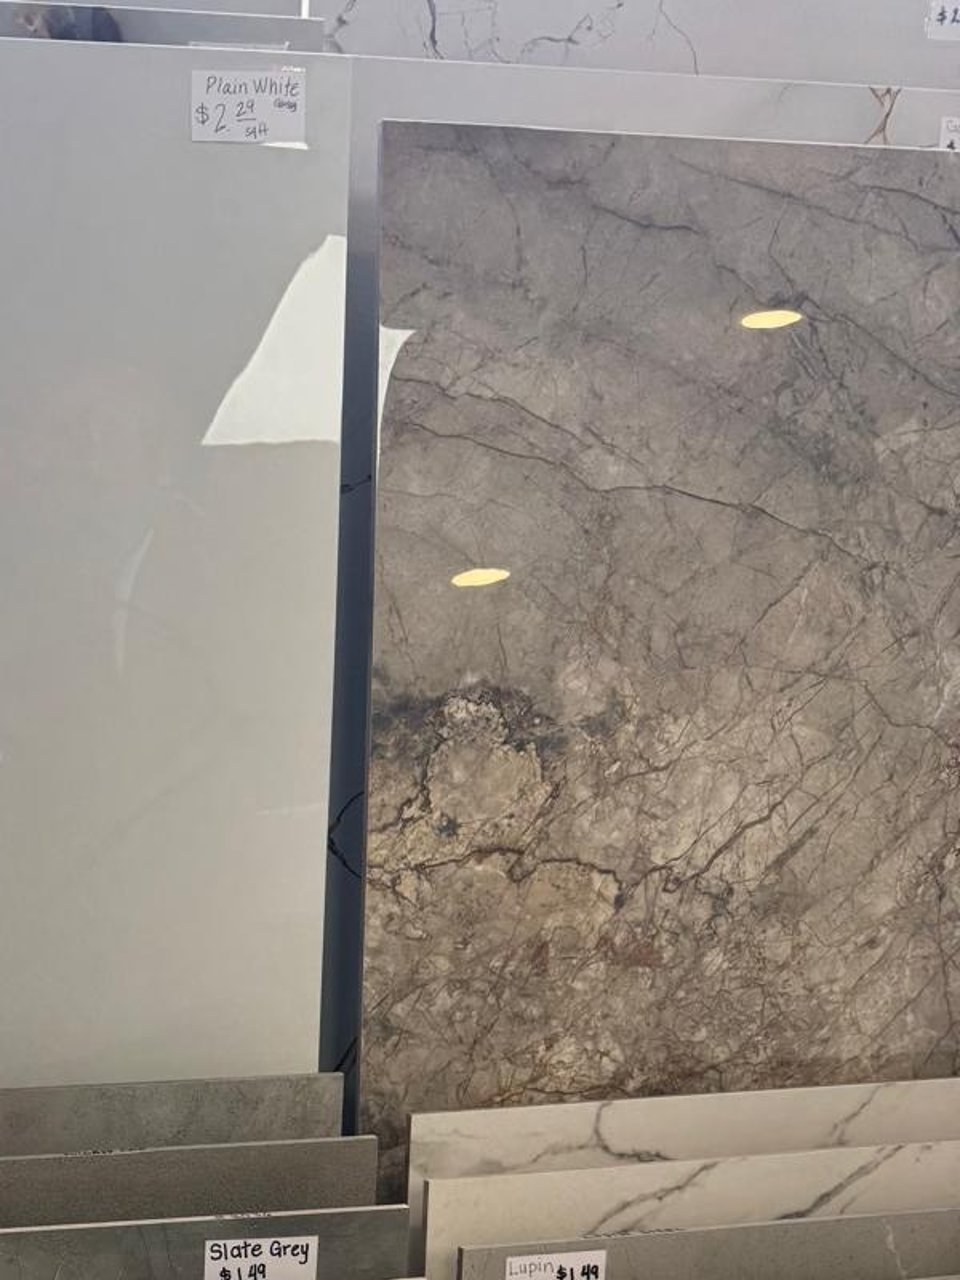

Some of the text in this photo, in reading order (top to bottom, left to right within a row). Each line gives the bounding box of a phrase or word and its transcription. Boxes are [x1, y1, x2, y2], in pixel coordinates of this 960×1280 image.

[205, 76, 300, 97] Plain White
[210, 1240, 309, 1265] Slate Grey
[509, 1258, 555, 1277] Lupin
